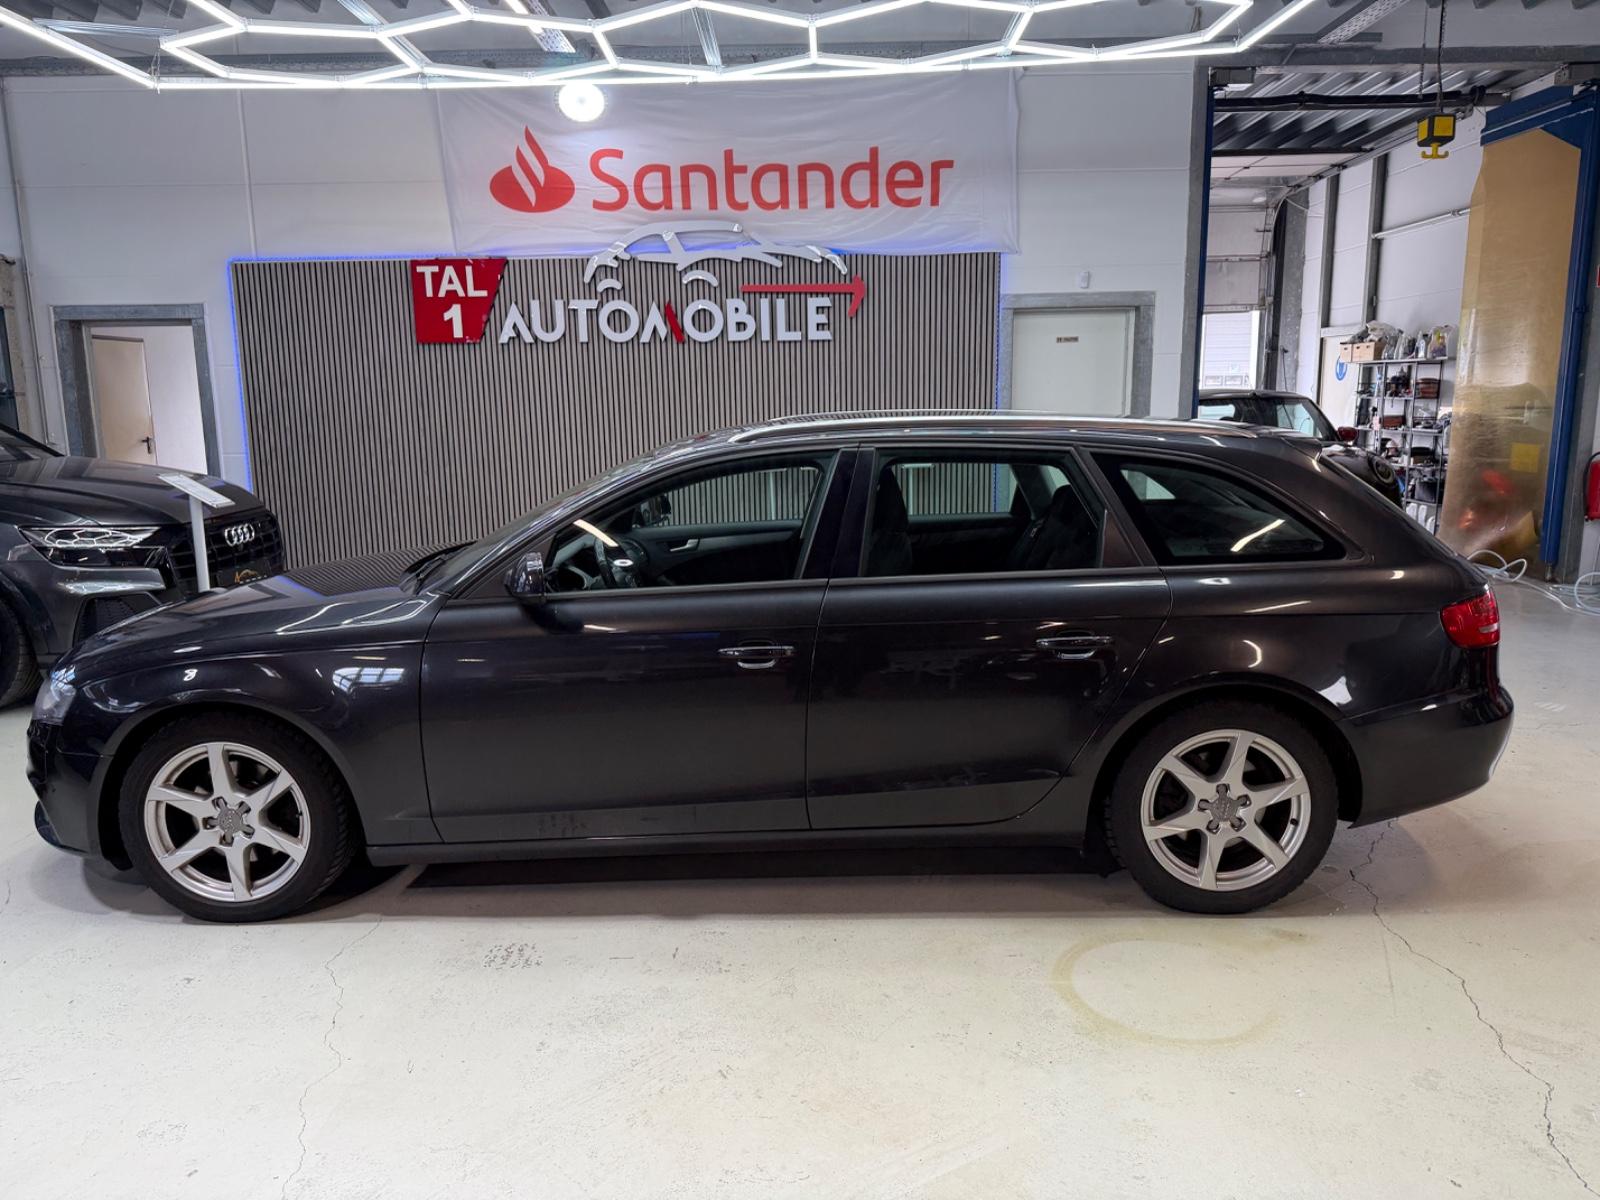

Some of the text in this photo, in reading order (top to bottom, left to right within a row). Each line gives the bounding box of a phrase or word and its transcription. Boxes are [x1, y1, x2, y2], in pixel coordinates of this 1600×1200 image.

[589, 146, 954, 211] Santander
[416, 265, 488, 298] TAL
[443, 303, 464, 339] 1
[499, 297, 833, 344] AUTOMOBILE
